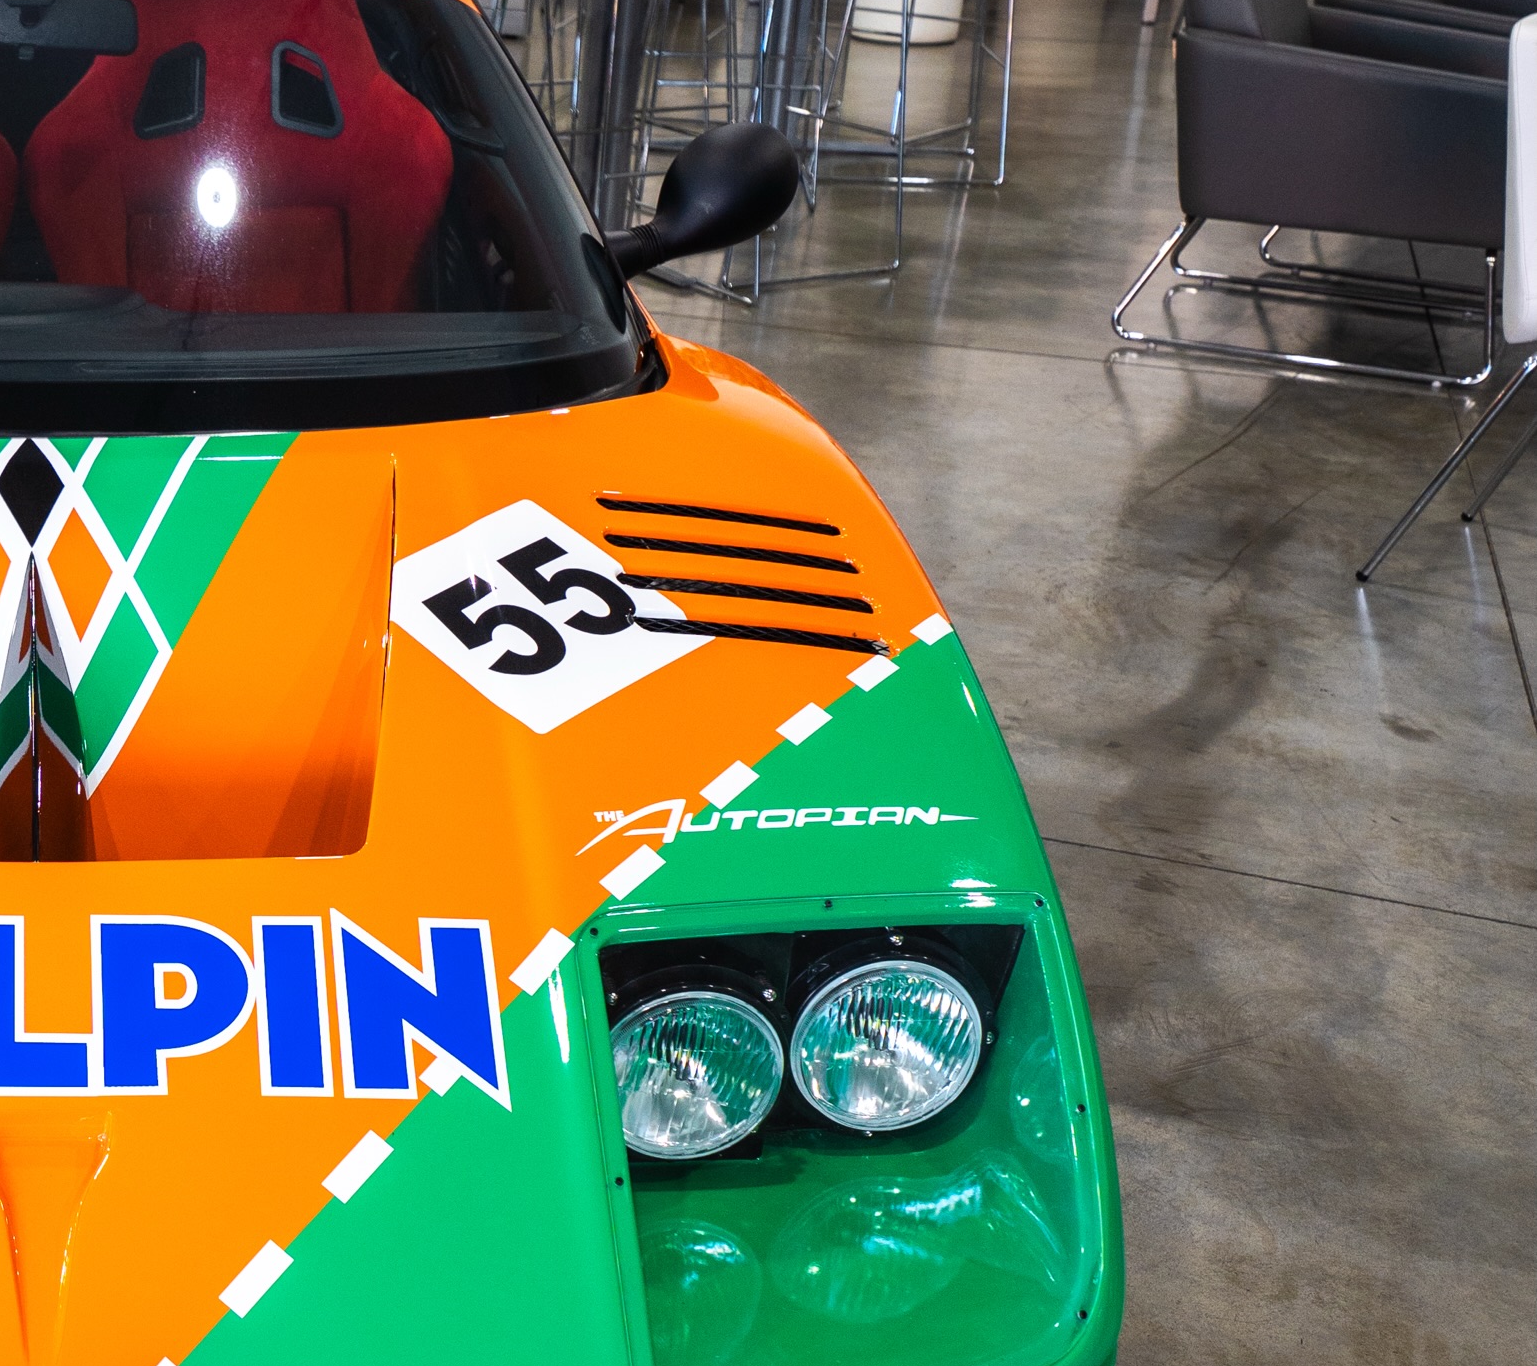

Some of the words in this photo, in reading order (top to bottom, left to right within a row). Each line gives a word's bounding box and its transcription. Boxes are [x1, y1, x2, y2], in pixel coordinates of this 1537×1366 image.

[422, 536, 637, 676] 55
[575, 798, 941, 857] AUTOPIAN
[593, 809, 625, 823] THE
